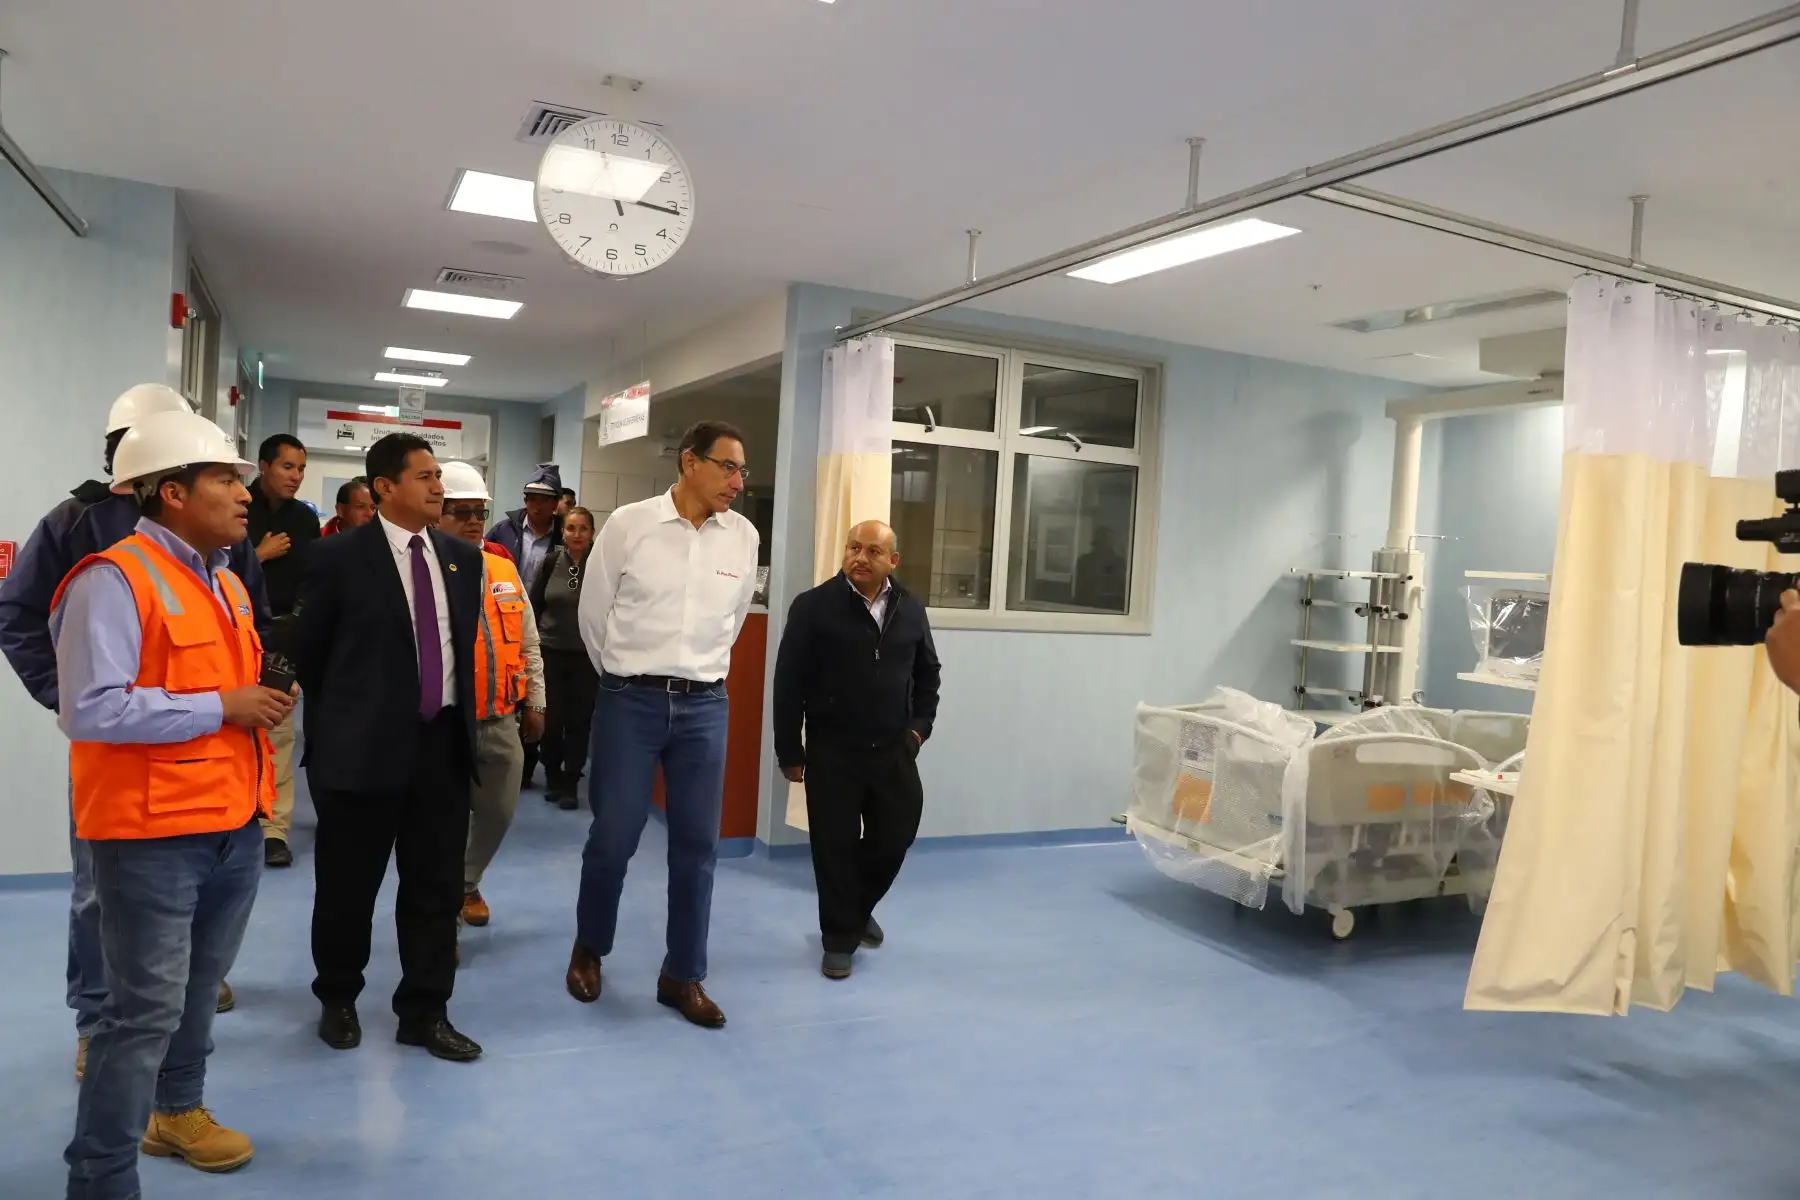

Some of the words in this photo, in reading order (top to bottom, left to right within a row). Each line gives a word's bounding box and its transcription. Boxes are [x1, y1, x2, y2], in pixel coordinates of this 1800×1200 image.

[584, 137, 596, 150] 11
[611, 133, 629, 147] 12
[645, 148, 651, 159] 1
[659, 171, 671, 183] 2
[559, 213, 571, 224] 8
[656, 228, 667, 239] 4
[579, 235, 592, 248] 7
[606, 248, 618, 260] 6
[634, 244, 647, 256] 5
